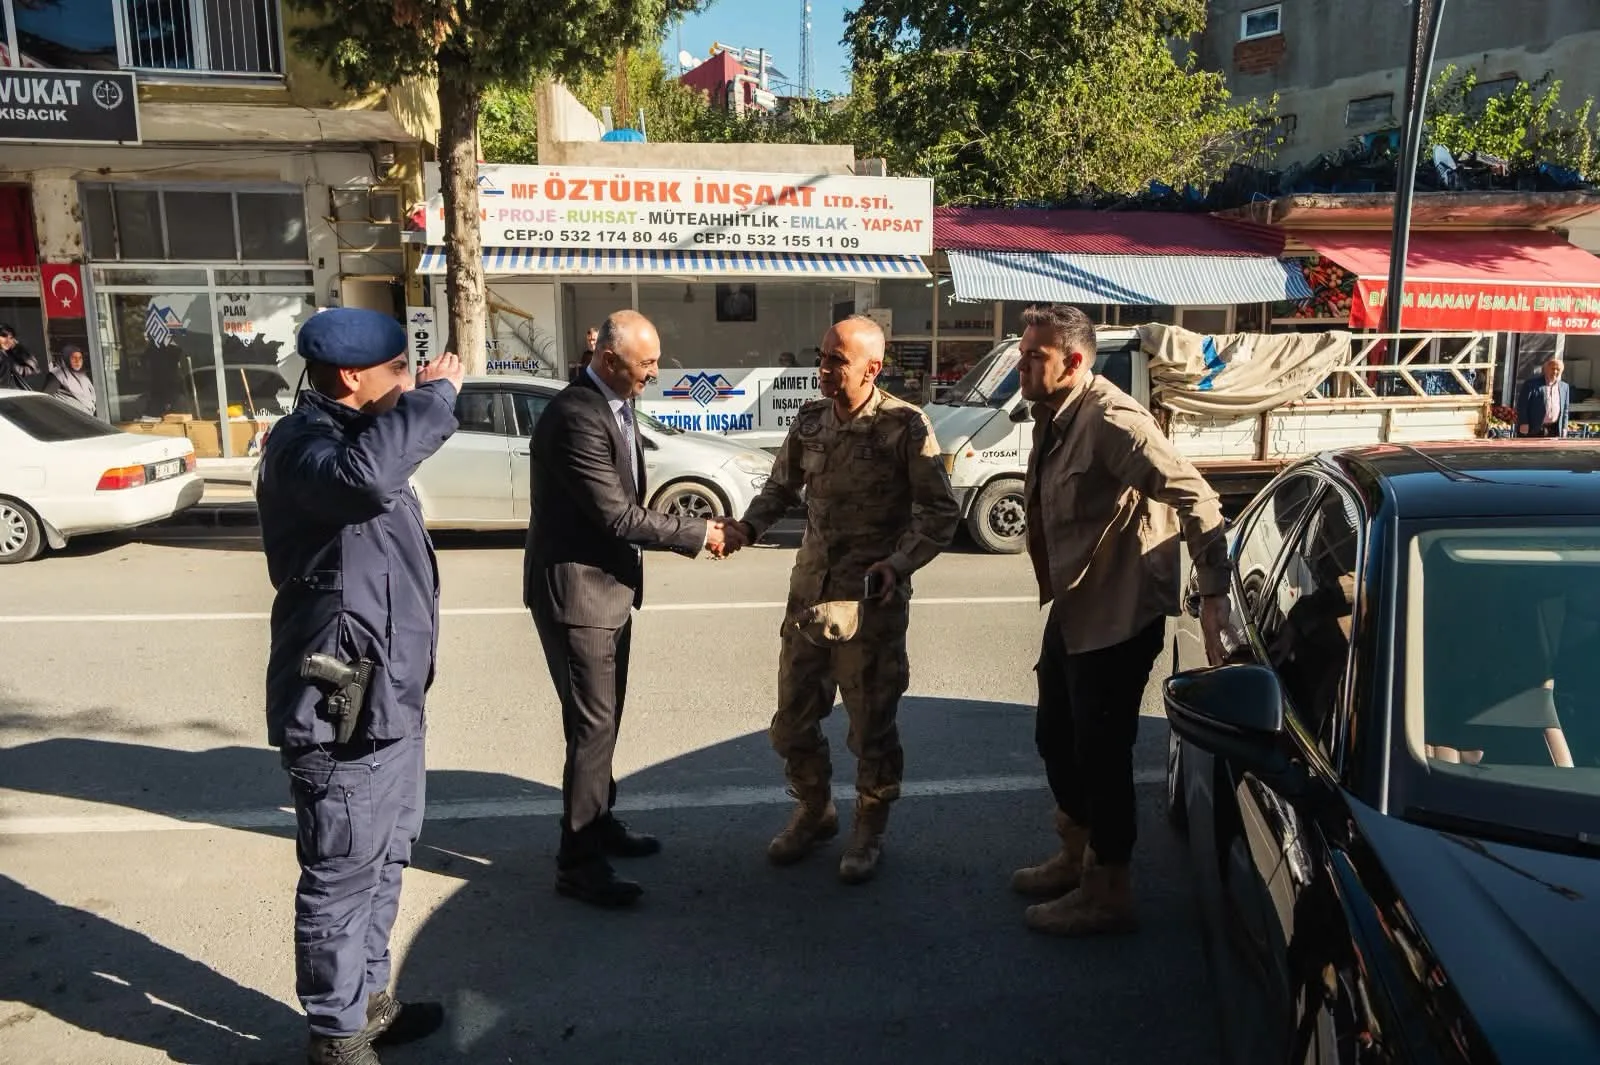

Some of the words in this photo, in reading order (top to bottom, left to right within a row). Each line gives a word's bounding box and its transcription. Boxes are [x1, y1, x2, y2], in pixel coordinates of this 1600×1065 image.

[0, 77, 81, 106] VUKAT
[0, 108, 68, 121] KISACIK
[511, 183, 538, 199] MF
[544, 172, 682, 203] ÖZTÜRK
[694, 176, 816, 211] İNŞAAT
[823, 194, 893, 212] LTD.ŞTİ.
[498, 208, 557, 223] PROJE
[567, 209, 637, 224] RUHSAT
[649, 209, 779, 228] MÜTEAHHİTLİK
[790, 215, 848, 230] EMLAK
[861, 218, 923, 232] YAPSAT
[560, 230, 591, 242] 532
[597, 231, 627, 243] 174
[632, 231, 652, 243] 80
[658, 231, 678, 243] 46
[747, 234, 776, 246] 532
[782, 235, 811, 247] 155
[817, 236, 833, 248] 11
[840, 237, 859, 249] 09
[1369, 287, 1414, 308] BİM
[1417, 291, 1475, 310] MANAV
[1478, 291, 1530, 312] İSMAİL
[223, 305, 247, 317] PLAN
[223, 321, 253, 334] PROJE
[773, 376, 808, 390] AHMET
[706, 409, 754, 434] İNŞAAT
[982, 449, 1018, 459] OTOSAN
